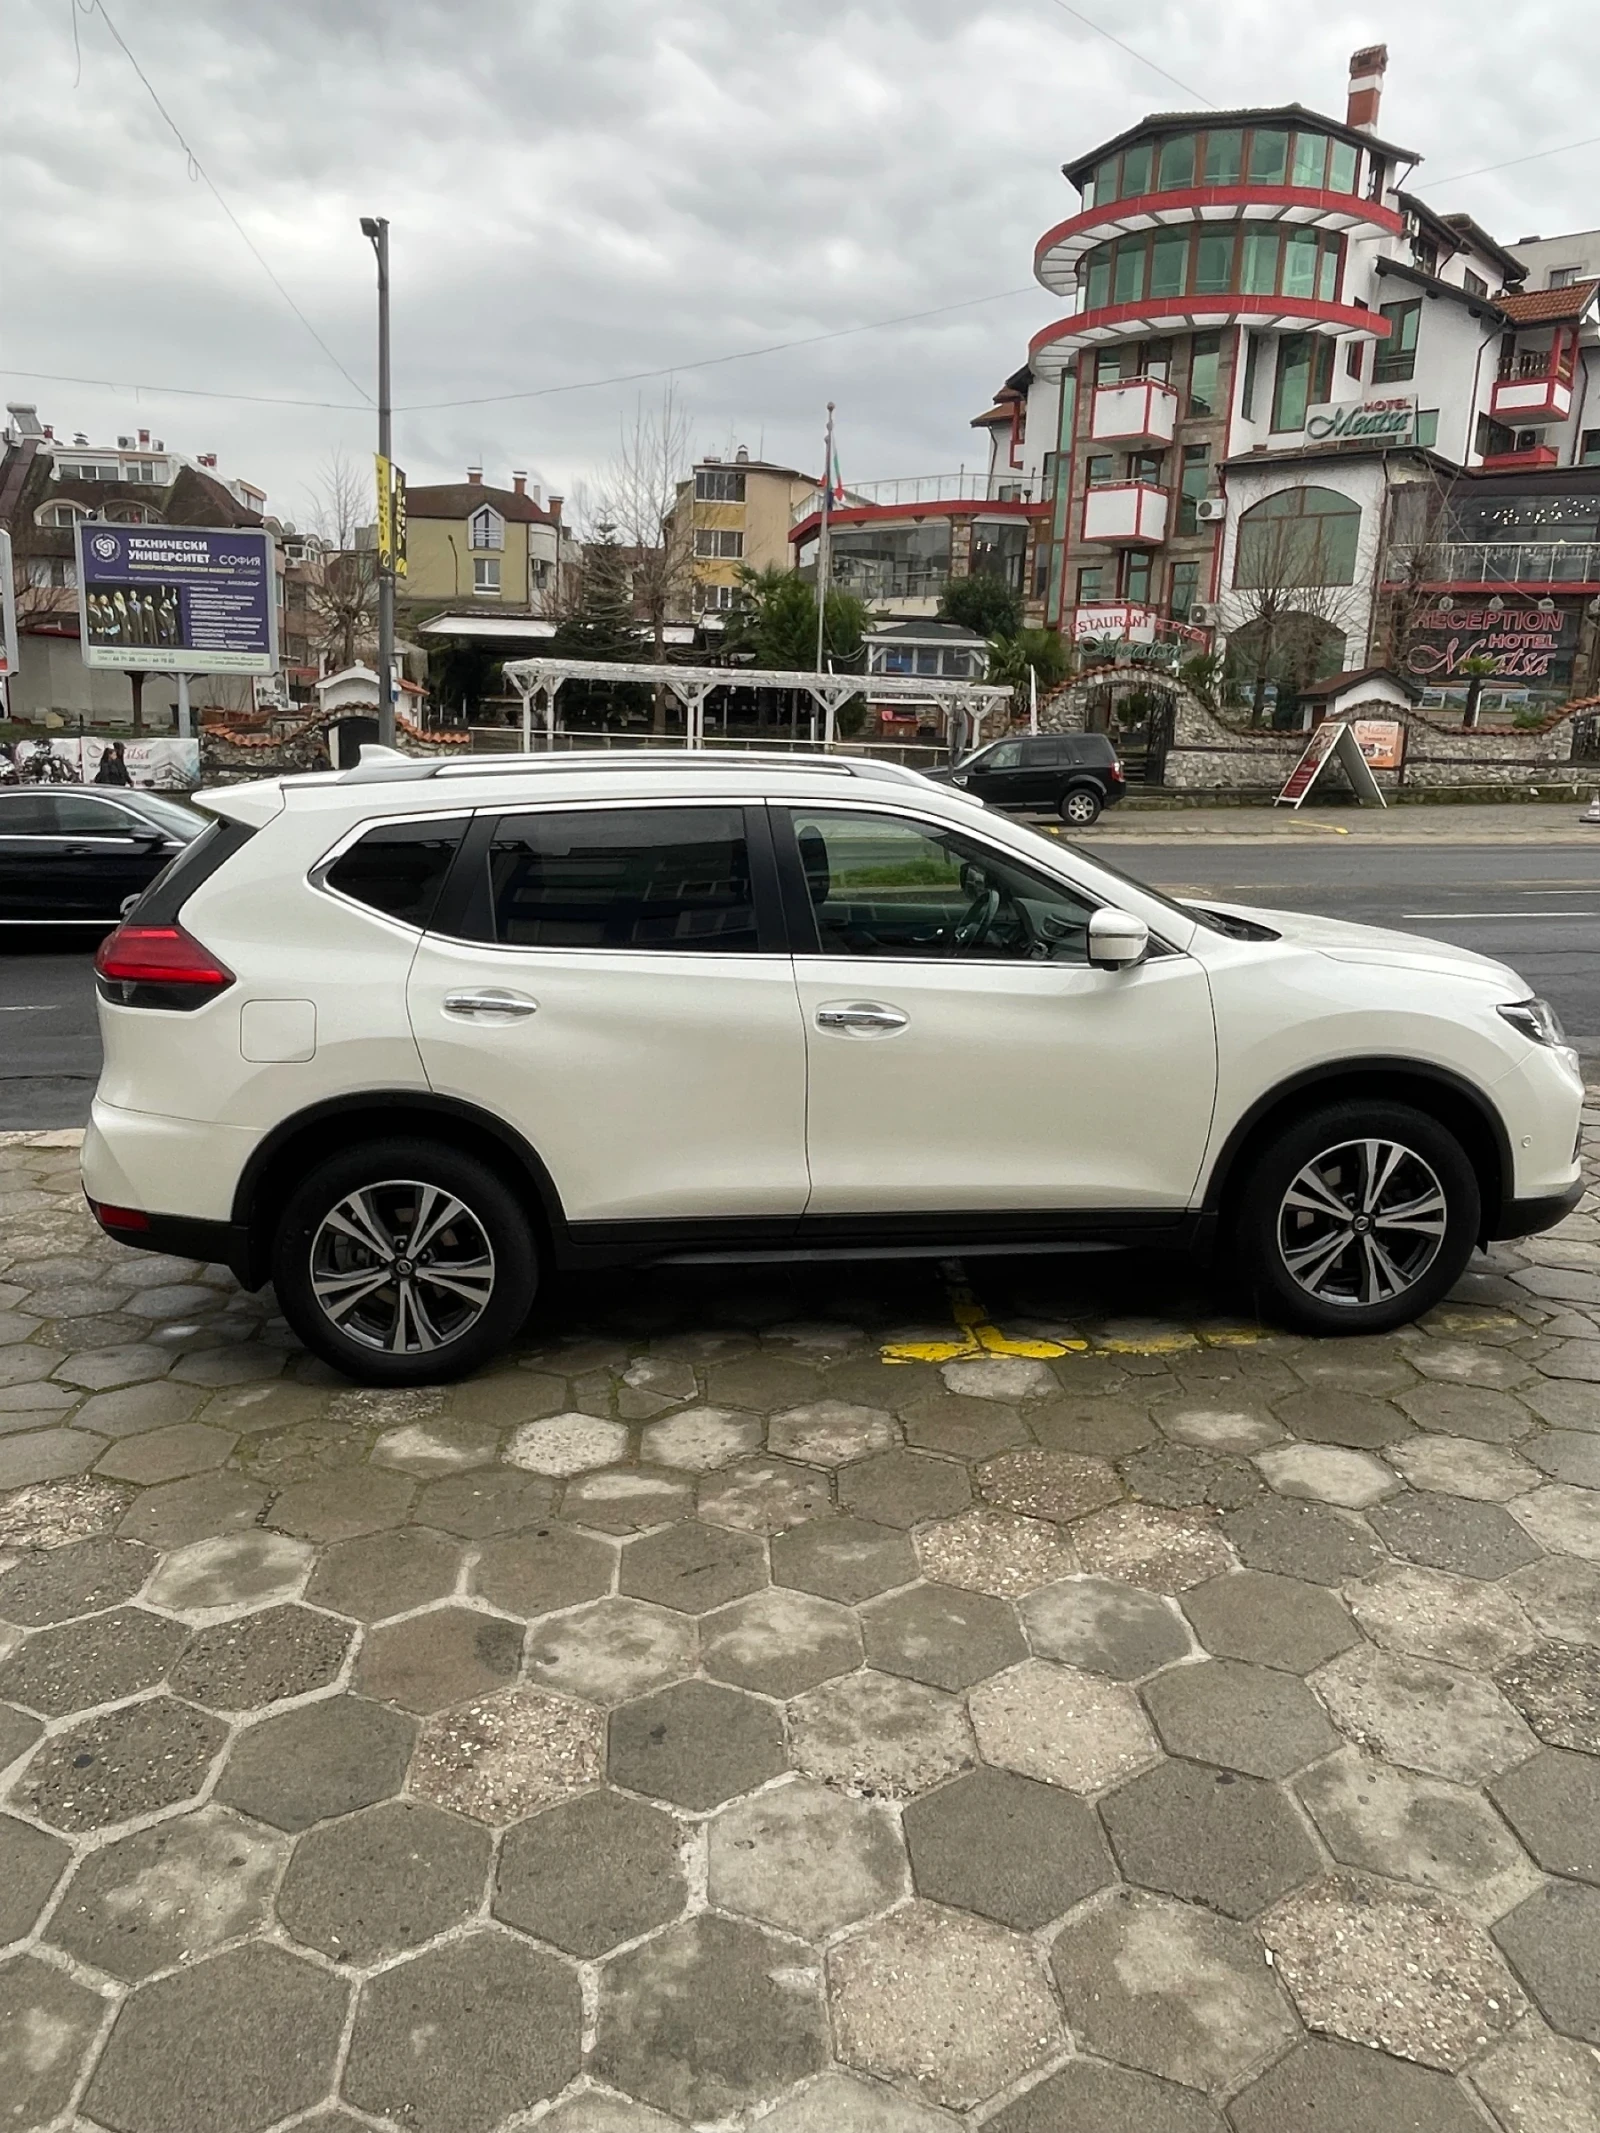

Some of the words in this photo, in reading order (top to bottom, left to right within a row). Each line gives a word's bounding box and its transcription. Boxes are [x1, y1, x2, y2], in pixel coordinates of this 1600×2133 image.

[1364, 398, 1412, 412] HOTEL
[1307, 407, 1412, 439] Meatsa
[128, 538, 208, 551] ТЕХНИЧЕСКИ
[128, 550, 210, 564] УНИВЕРСИТЕТ
[219, 554, 261, 566] СОФИЯ
[1412, 610, 1564, 632] RECEPTION
[1079, 632, 1187, 660] Meatsa
[1488, 633, 1558, 649] HOTEL
